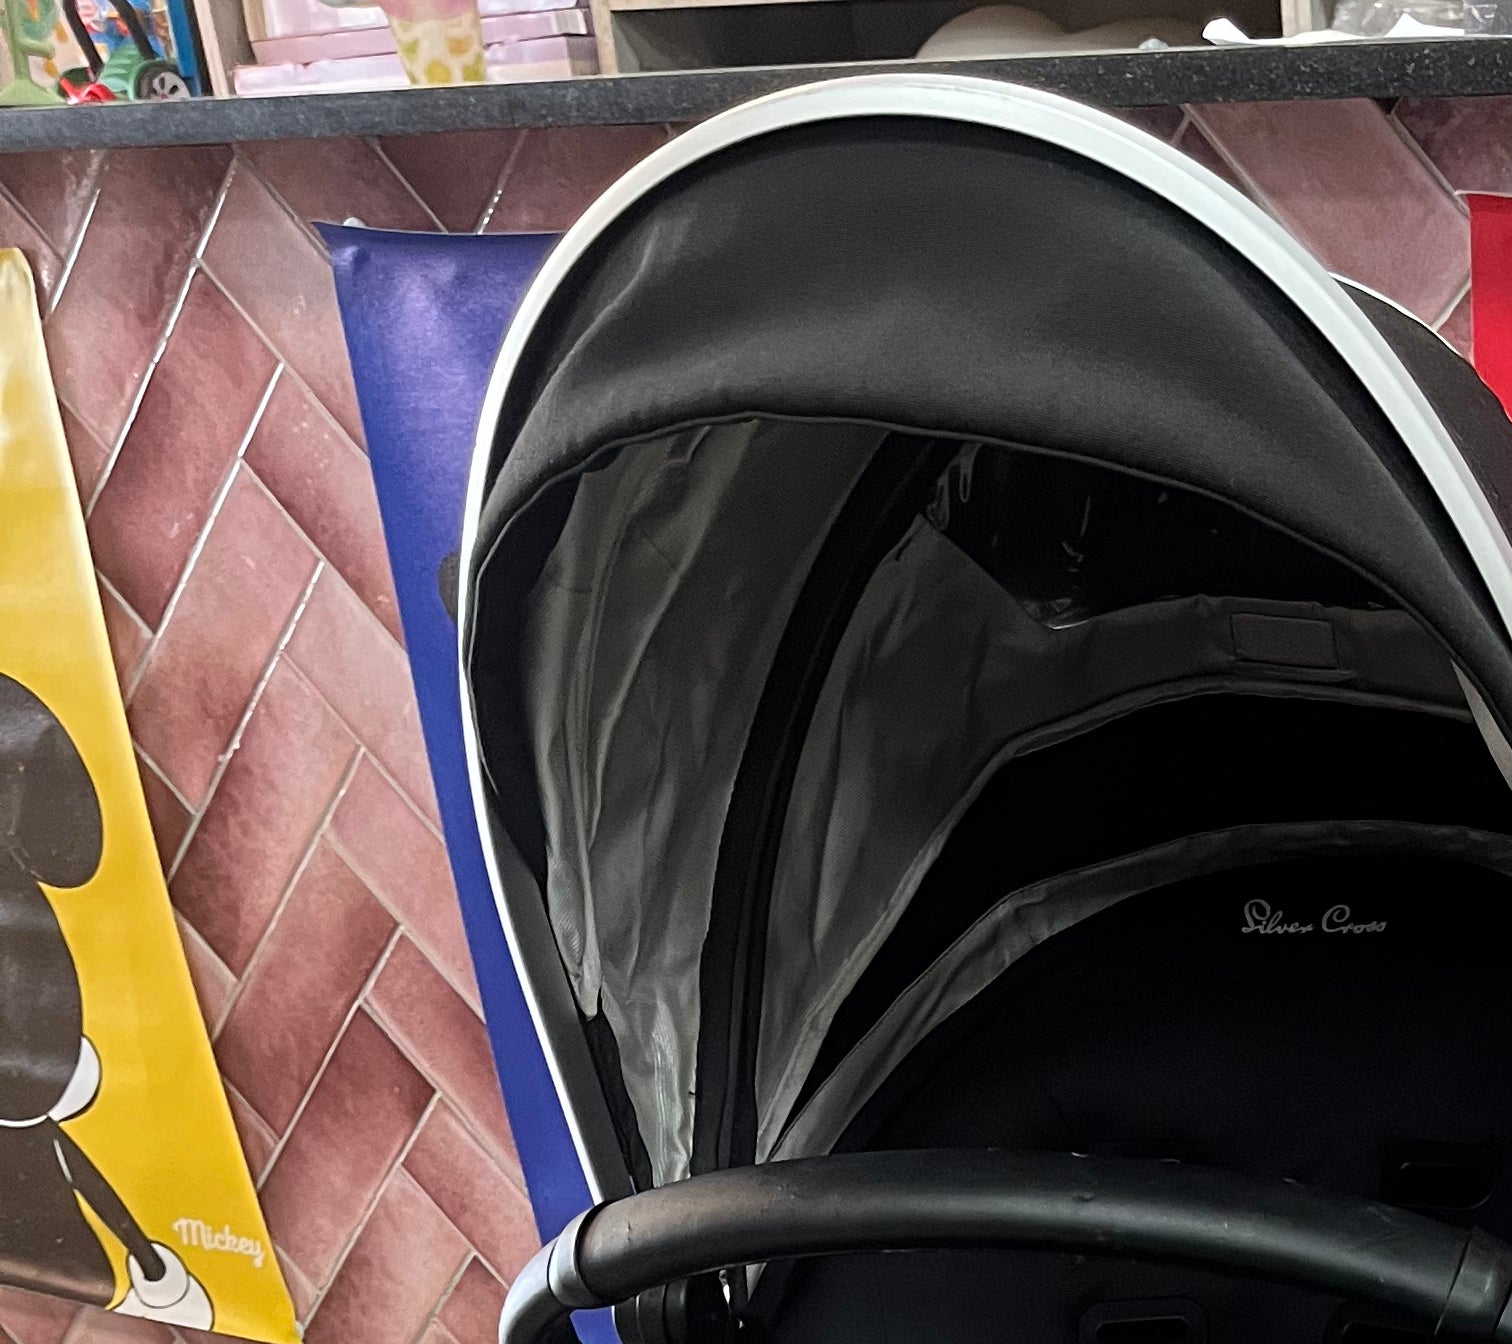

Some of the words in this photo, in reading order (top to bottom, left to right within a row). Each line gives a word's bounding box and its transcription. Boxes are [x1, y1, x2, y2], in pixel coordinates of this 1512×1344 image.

[1241, 898, 1314, 934] Silver
[1321, 904, 1387, 934] Cross
[172, 1217, 266, 1269] Mickey
